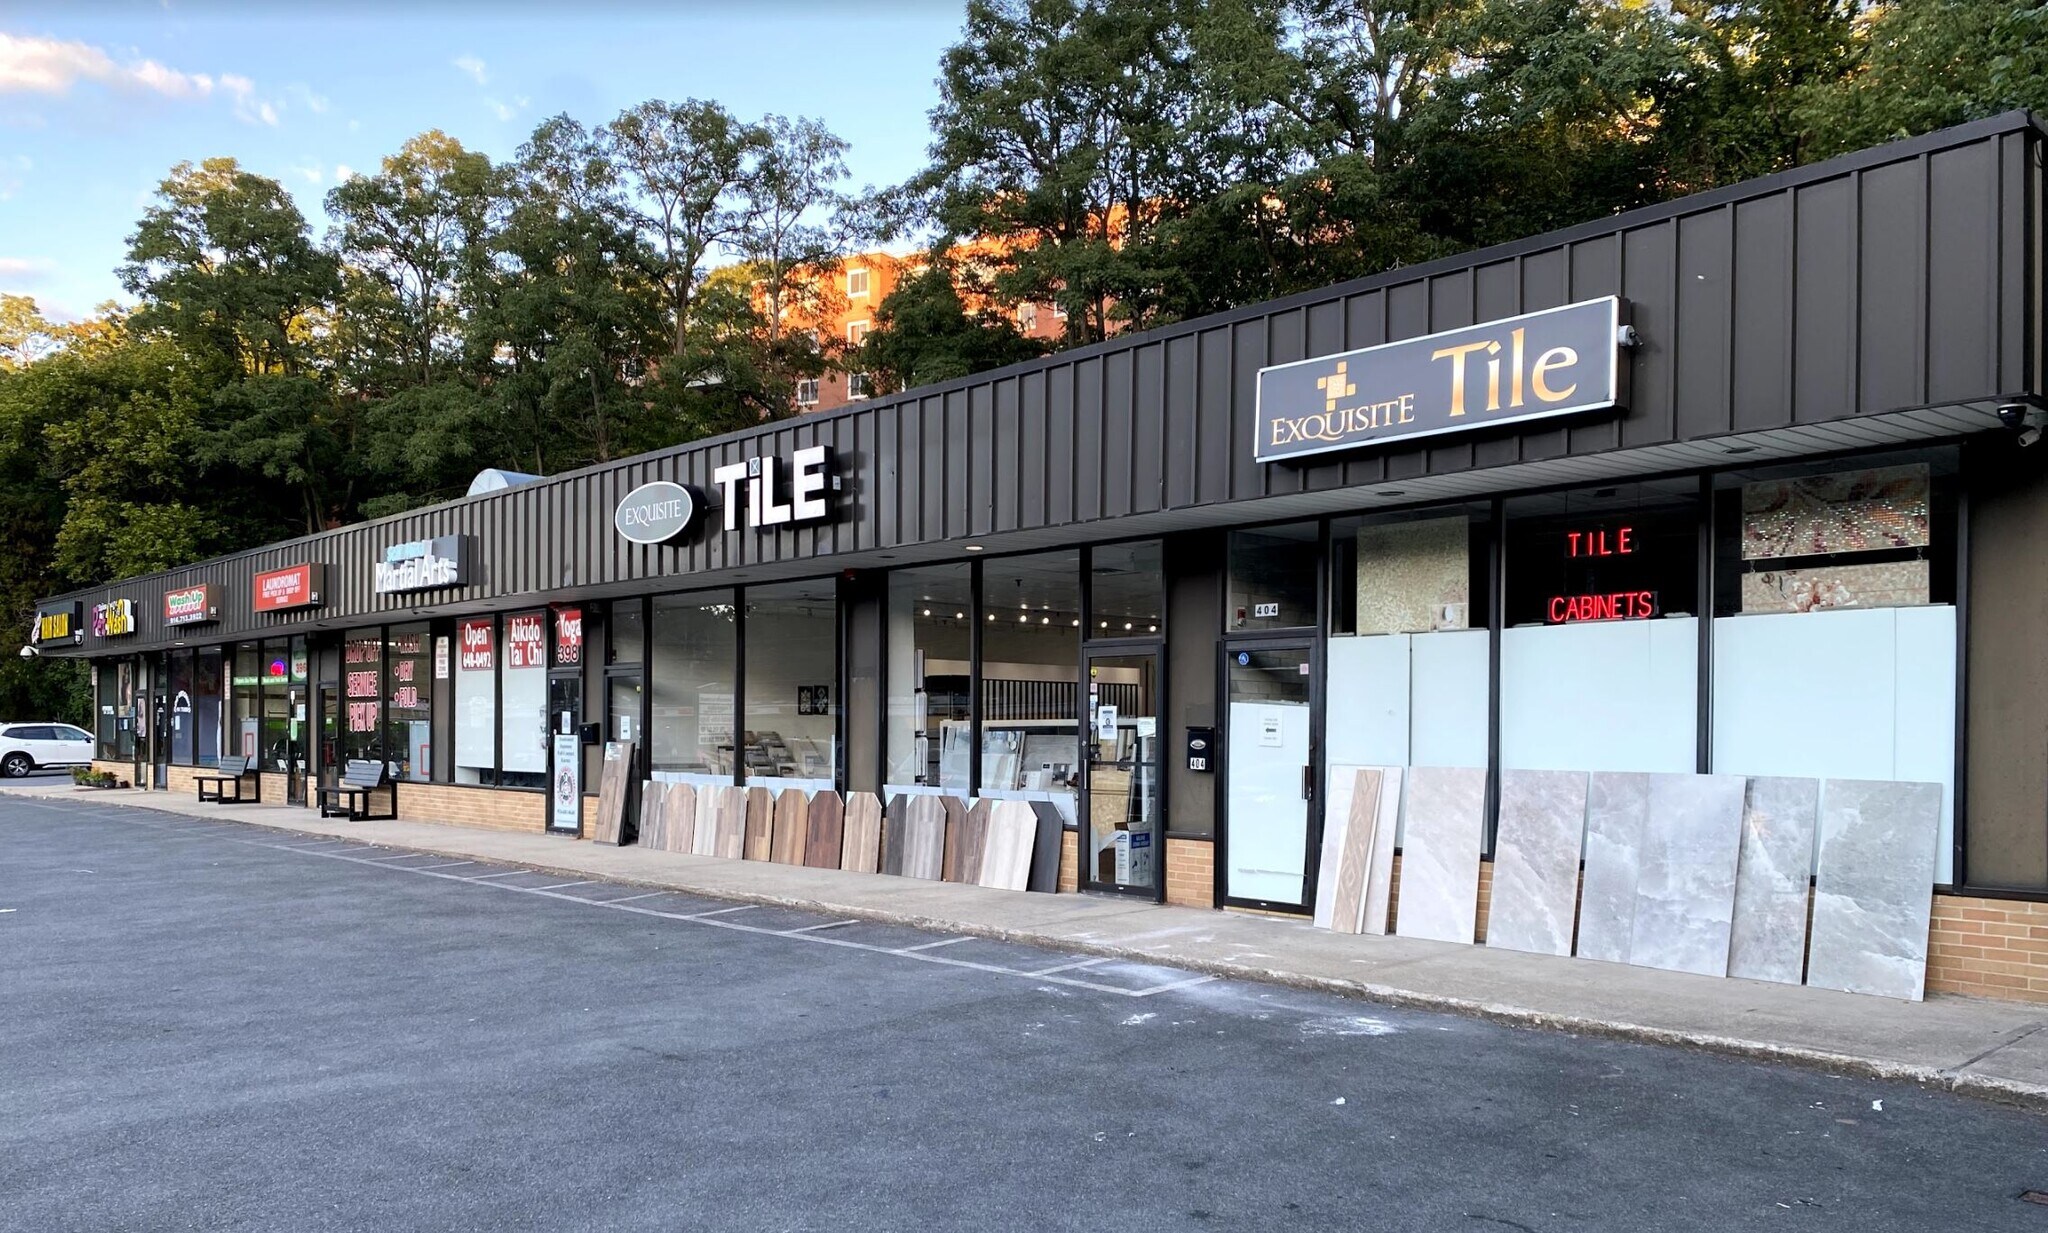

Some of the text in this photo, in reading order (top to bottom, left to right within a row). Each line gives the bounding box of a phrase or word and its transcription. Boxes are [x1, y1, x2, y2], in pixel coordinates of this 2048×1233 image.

[1431, 327, 1578, 417] Tile
[1270, 393, 1415, 446] EXQUISITE
[625, 499, 682, 527] EXQUISITE
[1568, 528, 1633, 557] TILE
[262, 573, 301, 592] LAUNDROMAT
[376, 555, 451, 593] Martial Arts
[169, 591, 204, 607] Wash Up
[1257, 605, 1277, 615] 404
[1550, 592, 1653, 623] CABINETS
[105, 604, 128, 636] Wash
[511, 618, 540, 641] Aikido
[559, 614, 582, 644] Yoga
[399, 634, 420, 653] WASH
[465, 623, 487, 652] Open
[346, 638, 380, 663] DROP OFF
[509, 641, 543, 665] Tai Chi
[558, 644, 579, 663] 398
[399, 660, 414, 681] DRY
[347, 671, 378, 697] SERVICE
[399, 686, 418, 708] FOLD
[349, 702, 378, 732] PICK UP
[1191, 758, 1205, 769] 404
